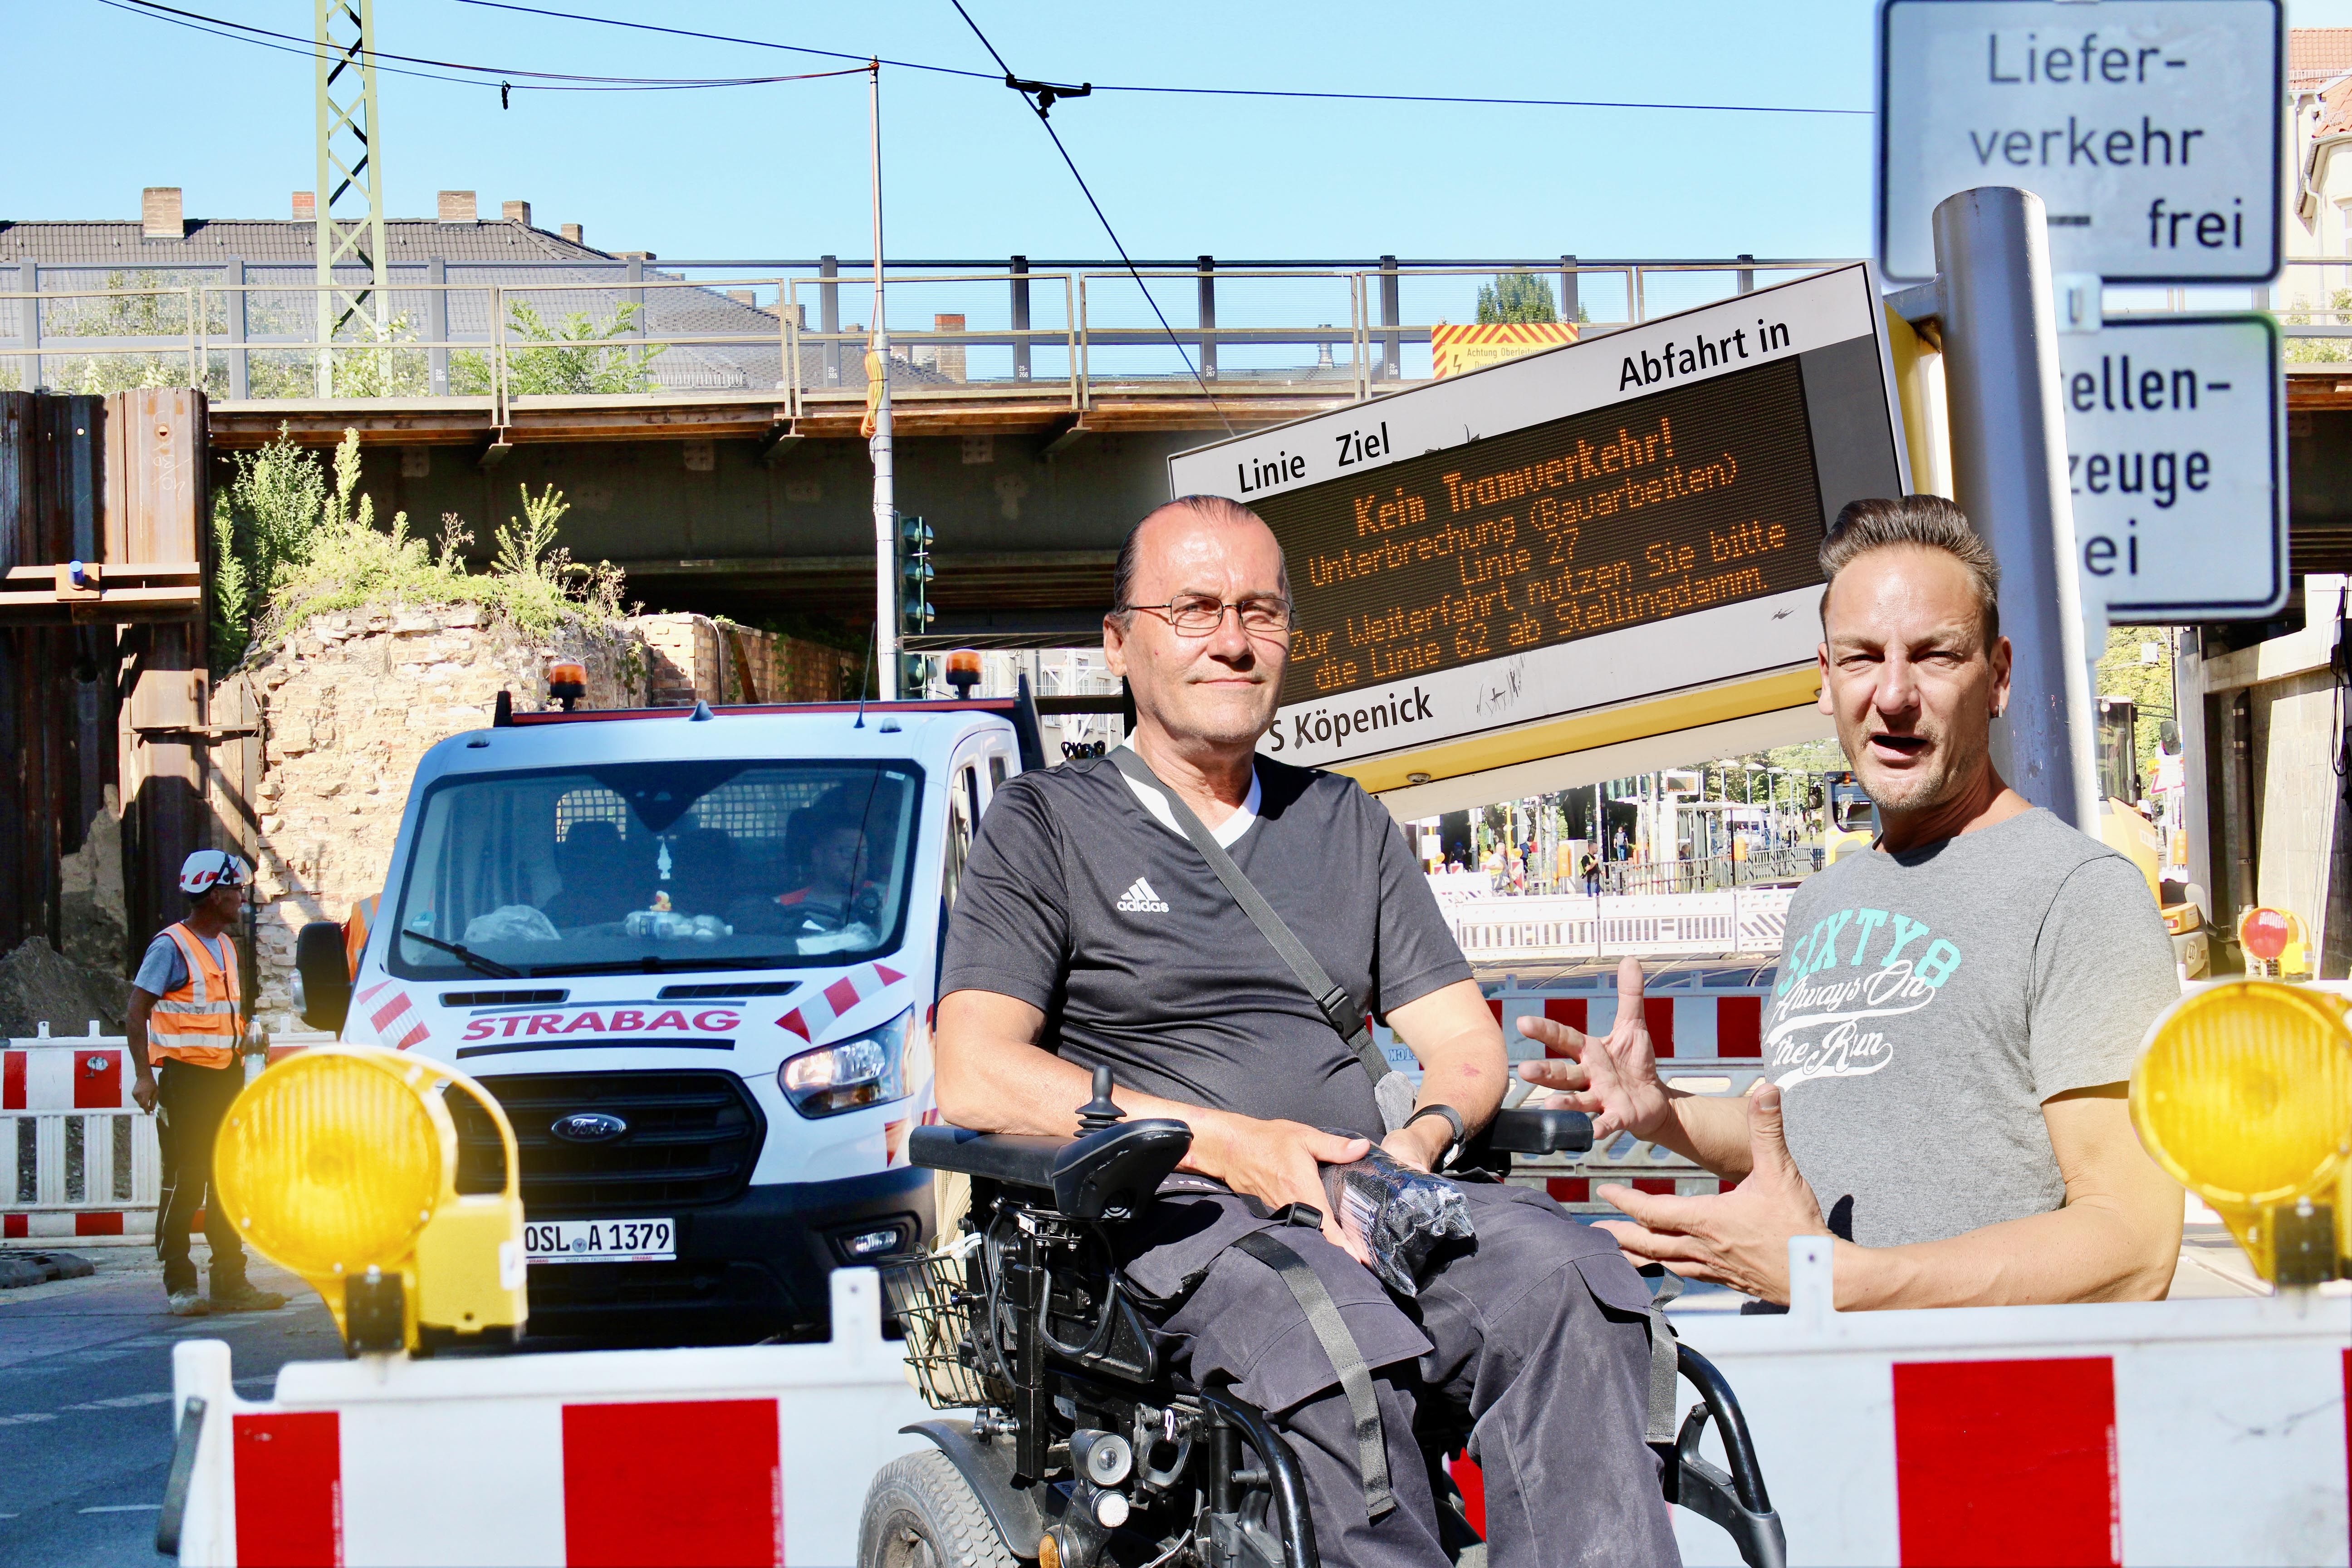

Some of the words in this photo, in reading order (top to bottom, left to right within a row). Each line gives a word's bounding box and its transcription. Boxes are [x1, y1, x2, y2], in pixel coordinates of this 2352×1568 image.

[1989, 33, 2187, 84] Liefer-
[1969, 115, 2205, 166] verkehr
[2149, 197, 2242, 249] frei
[1467, 348, 1497, 358] Achtung
[1619, 328, 1749, 392] Abfahrt
[1757, 318, 1790, 353] in
[2060, 354, 2232, 412] ellen-
[1238, 451, 1305, 493] Linie
[1336, 421, 1390, 467] Ziel
[1355, 487, 1426, 536] Kein
[1442, 417, 1674, 512] Tramverkehr!
[1310, 516, 1516, 586] Unterbrechung
[1530, 453, 1737, 530] (Bauarbeiten)
[2075, 518, 2138, 577] ei
[1460, 548, 1531, 586] Linie
[1546, 527, 1579, 564] 27
[1290, 630, 1333, 662] Zur
[1348, 581, 1514, 647] Weiterfahrt
[1528, 561, 1632, 606] nutzen
[1646, 542, 1695, 578] Sie
[1710, 520, 1786, 562] bitte
[1315, 657, 1358, 690] die
[1371, 637, 1441, 677] Linie
[1455, 622, 1491, 658] 62
[1509, 612, 1542, 646] ab
[1555, 568, 1768, 635] Stellingdamm.
[1270, 720, 1285, 752] S
[1294, 686, 1434, 748] Köpenick
[1117, 899, 1170, 913] adidas
[2188, 943, 2196, 960] 40
[1764, 974, 1861, 1032] Always
[1863, 959, 1929, 1005] On
[461, 1010, 741, 1040] STRABAG
[1772, 1034, 1809, 1067] the
[1803, 1021, 1884, 1075] Run
[568, 1118, 608, 1135] Ford
[524, 1225, 570, 1251] OSL
[588, 1225, 603, 1251] A
[609, 1223, 670, 1250] 1379
